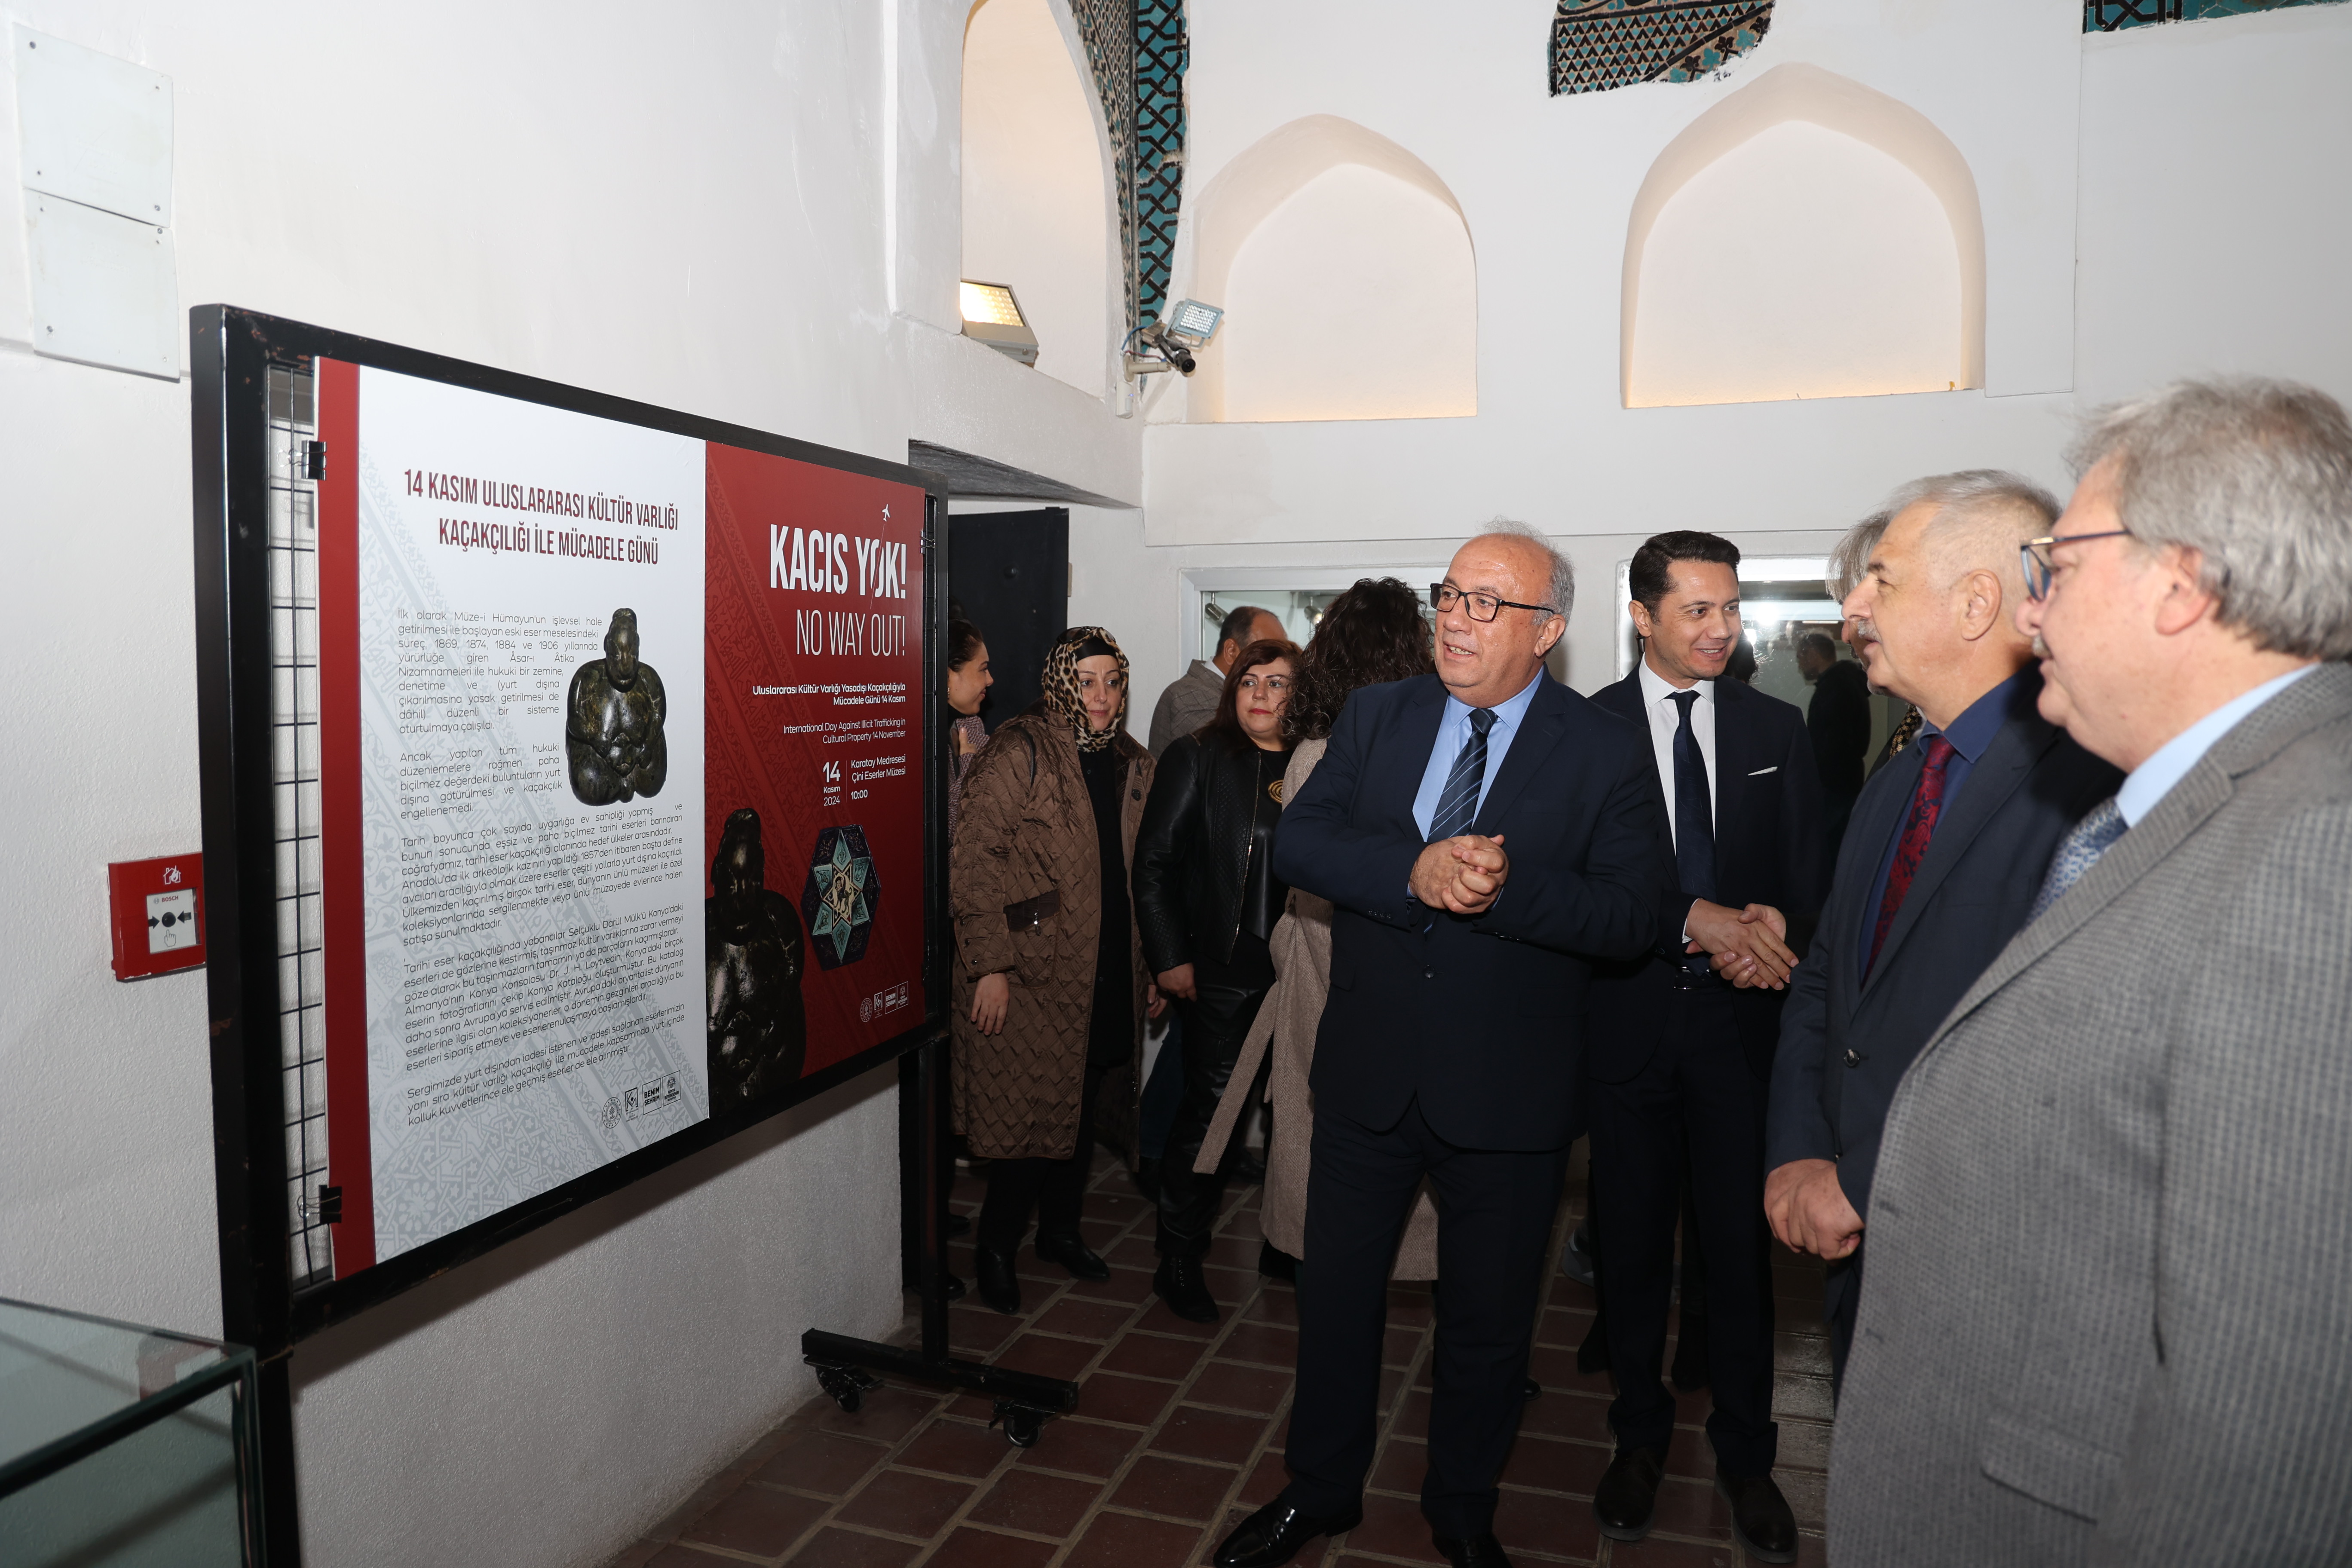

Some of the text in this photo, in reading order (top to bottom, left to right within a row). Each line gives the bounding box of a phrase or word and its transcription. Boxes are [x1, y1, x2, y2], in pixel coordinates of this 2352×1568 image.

[404, 469, 678, 531] 14 KASIM ULUSLARARASI KÜLTÜR VARLIĞI
[439, 518, 658, 565] KAÇAKÇILIĞI İLE MÜCADELE GÜNÜ
[398, 608, 602, 627] İlk olarak Müze-i Hümayun'un işlevsel hale
[398, 624, 448, 636] getirilmesi
[450, 625, 460, 635] ile
[462, 625, 503, 637] başlayan
[505, 627, 522, 636] eski
[543, 628, 598, 638] meselesindeki
[796, 609, 905, 657] NO WAY OUT!
[398, 640, 427, 650] süreç,
[435, 639, 459, 650] 1869,
[466, 639, 488, 650] 1874,
[495, 640, 516, 649] 1884
[539, 641, 558, 650] 1906
[564, 641, 598, 652] yıllarında
[398, 652, 444, 665] yürürlüğe
[466, 653, 489, 665] giren
[554, 652, 574, 662] Âtika
[398, 666, 564, 677] Nizamnameleri ile hukuki bir zemine,
[398, 681, 445, 691] denetime
[498, 680, 517, 691] (yurt
[536, 679, 560, 690] dışına
[752, 682, 906, 695] Uluslararası Kültür Varlığı Yasadışı Kaçakçılığıyla
[399, 692, 559, 707] çıkarılmasına yasak getirilmesi de
[833, 694, 906, 706] Mücadele Günü 14 Kasım
[399, 705, 559, 720] dâhil) düzenli bir sisteme
[399, 720, 495, 734] oturtulmaya çalışıldı.
[783, 717, 906, 734] International Day Against Illicit Trafficking in
[822, 729, 906, 744] Cultural Property 14 November
[400, 743, 559, 762] Ancak yapılan tüm hukuki
[851, 753, 906, 769] Karatay Medresesi
[400, 756, 559, 777] düzenlemelere rağmen paha
[823, 760, 841, 783] 14
[851, 766, 906, 784] Çini Eserler Müzesi
[400, 768, 561, 792] biçilmez değerdeki buluntuların yurt
[400, 795, 429, 806] dışına
[440, 789, 494, 803] götürülmesi
[523, 780, 563, 793] kaçakçılık
[823, 786, 841, 794] Kasım
[850, 789, 868, 800] 10:00
[824, 795, 841, 806] 2024
[401, 803, 474, 821] engellenemedi.
[401, 836, 425, 847] Tarih
[433, 831, 474, 844] boyunca
[481, 827, 497, 839] çok
[504, 822, 532, 835] sayıda
[538, 817, 575, 831] uygarlığa
[595, 810, 624, 821] sahipliği
[628, 808, 653, 819] yapmış
[401, 850, 432, 861] bunun
[439, 841, 490, 857] sonucunda
[496, 839, 518, 849] eşsiz
[538, 832, 559, 844] paha
[564, 827, 595, 839] biçilmez
[600, 823, 618, 833] tarihi
[622, 819, 646, 830] eserleri
[650, 815, 682, 826] barındıran
[404, 959, 430, 974] Tarihi
[434, 956, 455, 968] eser
[458, 941, 521, 962] kaçakçılığında
[524, 931, 566, 949] yabancılar
[568, 922, 600, 937] Selçuklu
[649, 903, 683, 918] Konya'daki
[407, 1075, 462, 1099] Sergimizde
[464, 1068, 482, 1084] yurt
[484, 1057, 521, 1075] dışından
[523, 1046, 546, 1063] iadesi
[548, 1039, 577, 1054] istenen
[578, 1035, 588, 1044] ve
[589, 1026, 610, 1041] iadesi
[612, 1017, 644, 1033] sağlanan
[408, 1044, 631, 1126] kolluk kuvvetlerince ele geçmiş eserler de ele alınmıştır.
